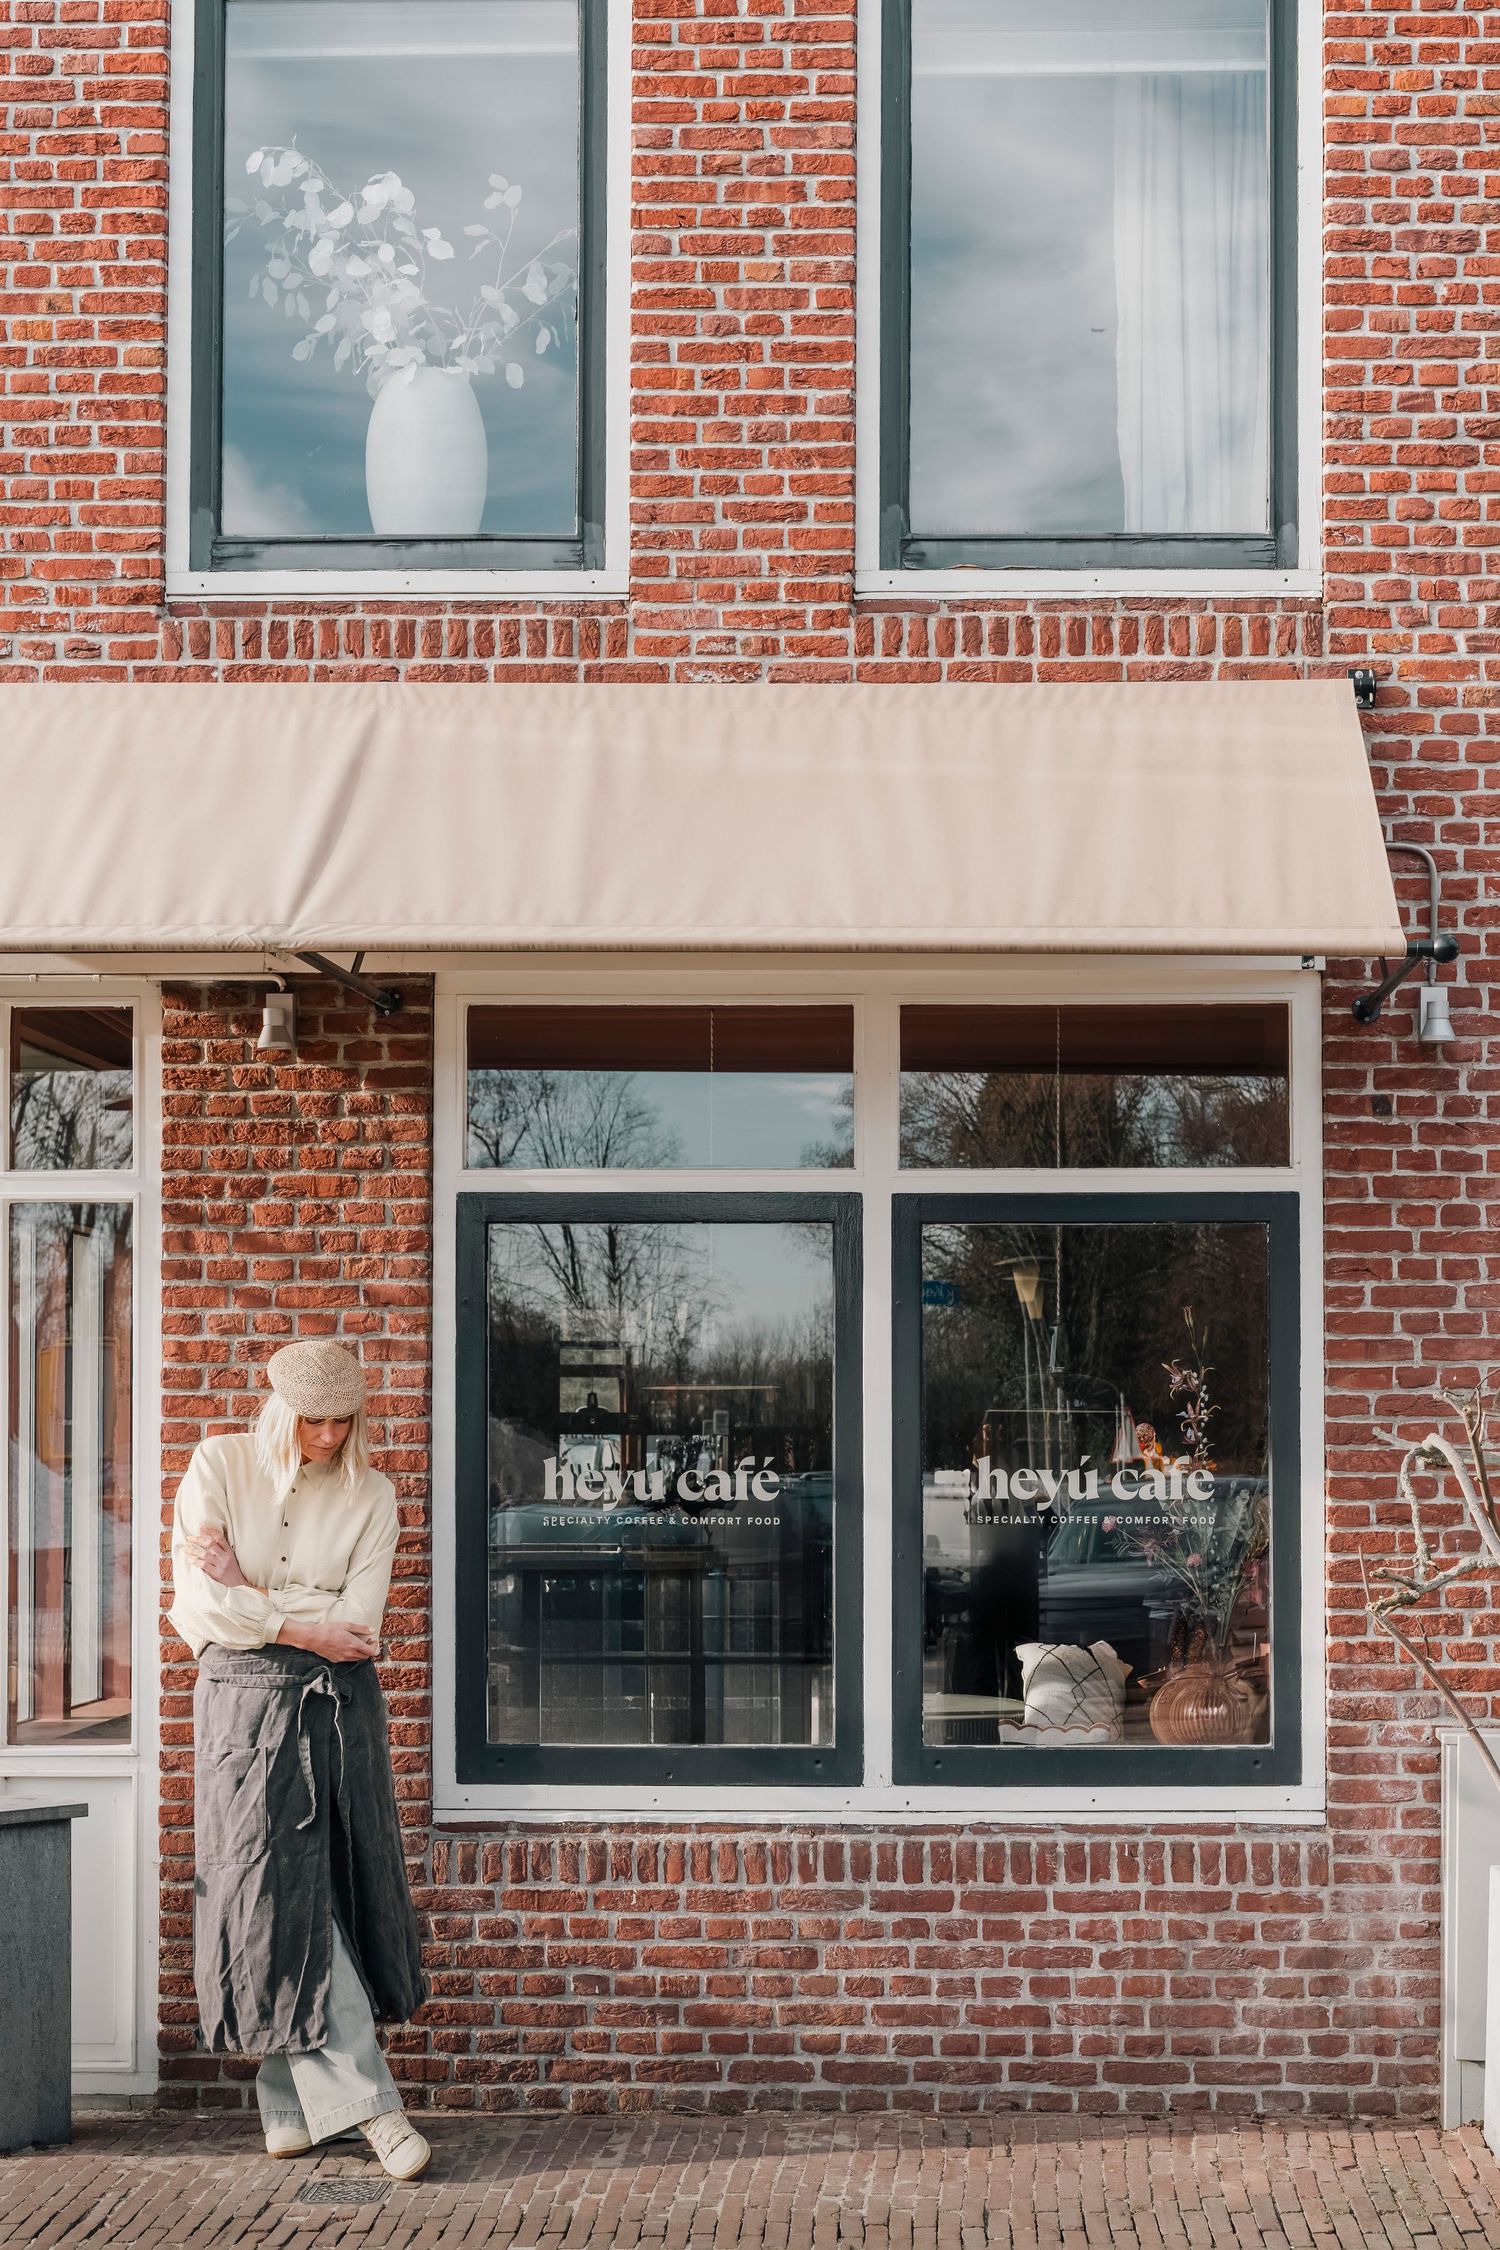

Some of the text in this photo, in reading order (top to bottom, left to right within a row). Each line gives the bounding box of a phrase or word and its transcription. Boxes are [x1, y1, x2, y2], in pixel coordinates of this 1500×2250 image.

[677, 1455, 780, 1502] café
[977, 1455, 1100, 1511] heyú
[543, 1516, 781, 1525] SPECIALTY COFFEE & COMFORT FOOD
[977, 1515, 1216, 1525] SPECIALTY COFFEE & COMFORT FOOD
